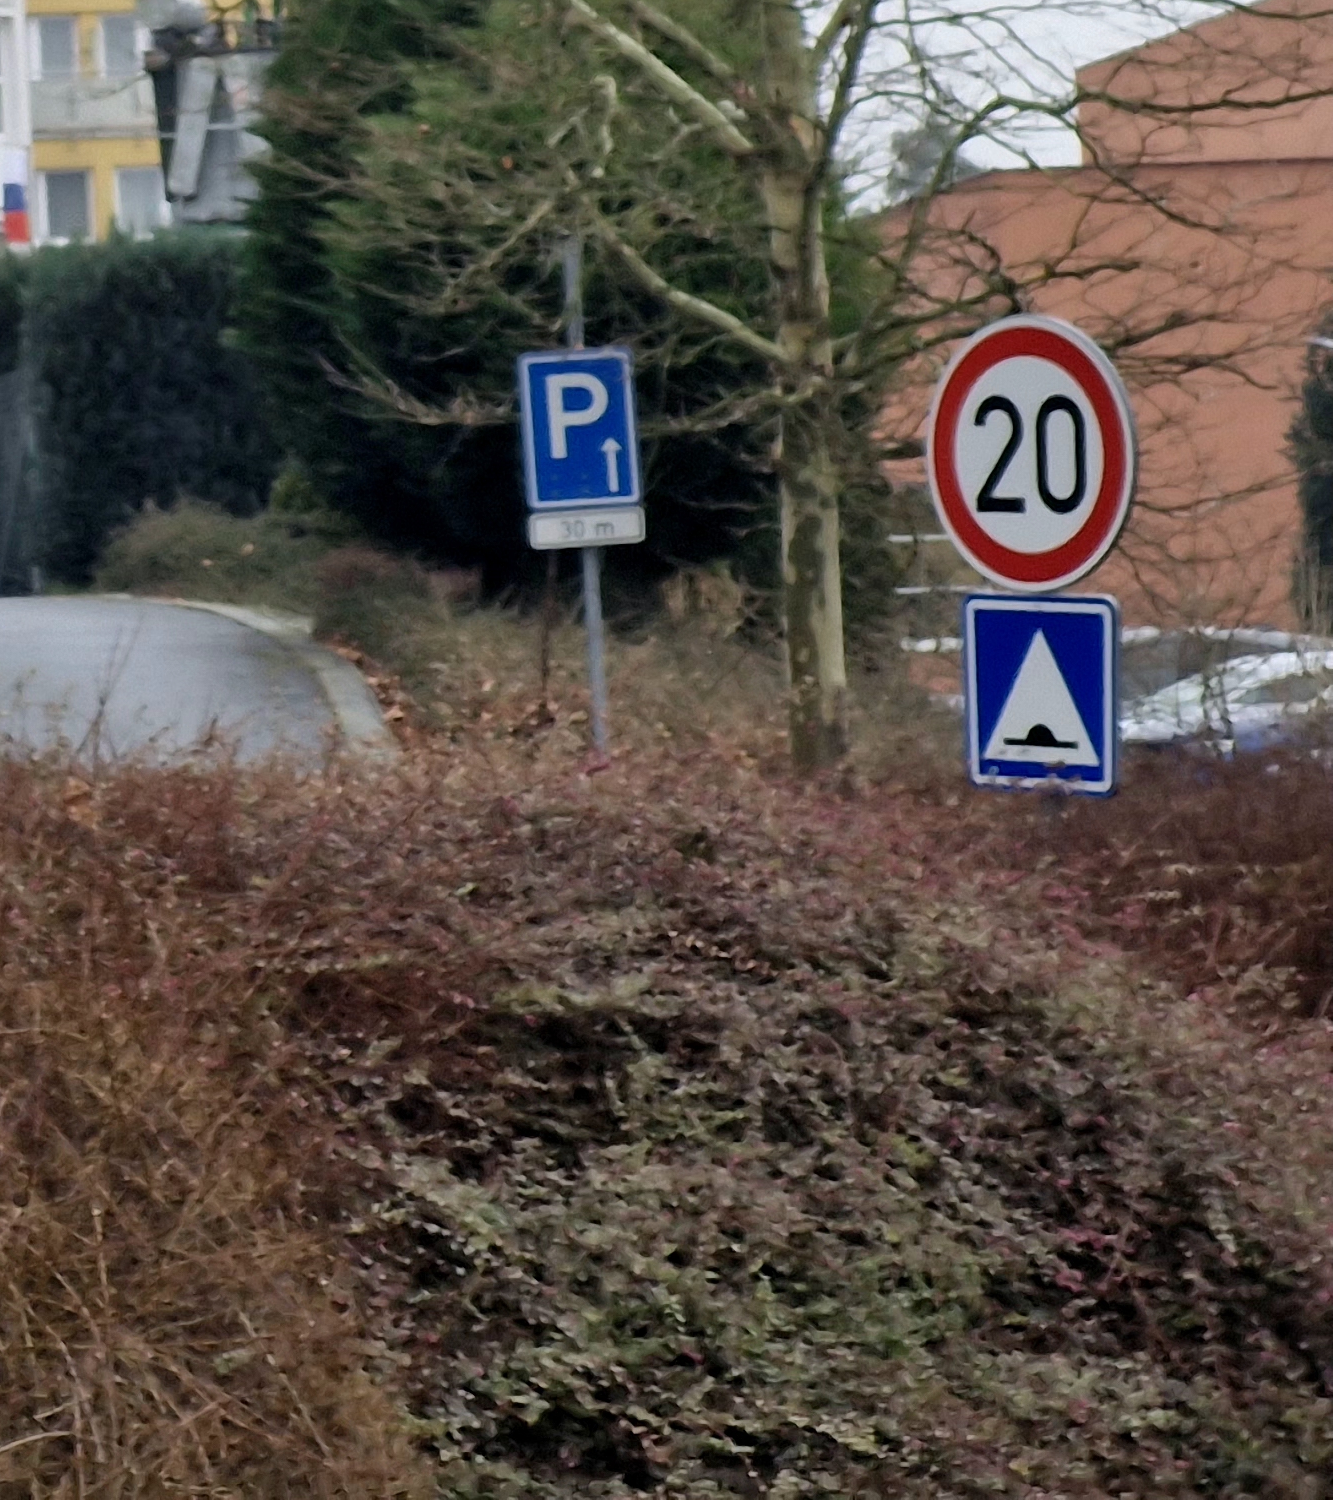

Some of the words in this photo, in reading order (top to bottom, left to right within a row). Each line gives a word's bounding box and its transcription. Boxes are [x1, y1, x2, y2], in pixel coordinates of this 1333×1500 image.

[545, 372, 609, 459] P
[973, 394, 1087, 515] 20
[560, 519, 585, 539] 30
[595, 521, 615, 537] m
